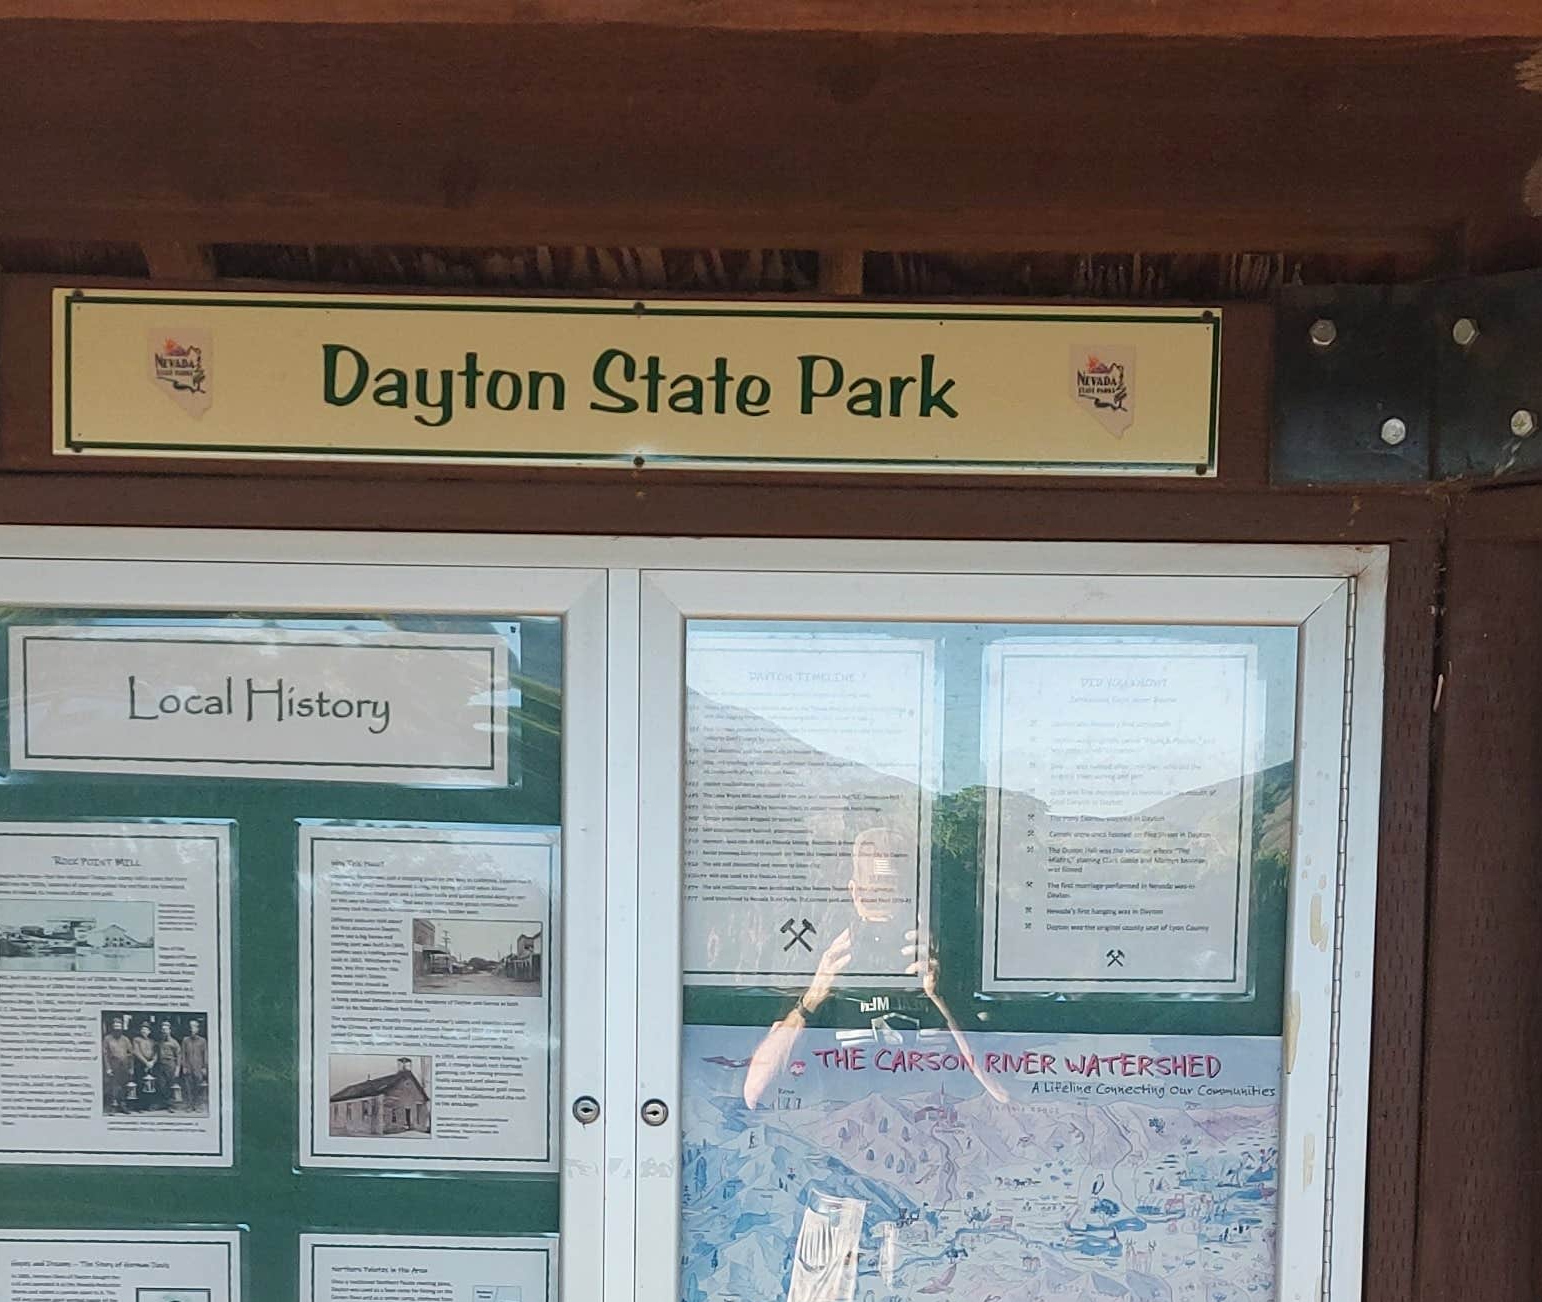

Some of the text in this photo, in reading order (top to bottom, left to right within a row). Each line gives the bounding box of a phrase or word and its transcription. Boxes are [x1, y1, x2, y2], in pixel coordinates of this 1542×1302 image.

[321, 343, 960, 426] Dayton State Park
[1077, 369, 1117, 385] NEVADA
[127, 675, 391, 734] Local History
[81, 857, 112, 867] POINT
[115, 857, 141, 867] MILL
[812, 1047, 1221, 1078] THE CARSON RIVER WATERSHED
[1031, 1083, 1040, 1094] A
[1045, 1082, 1091, 1094] Lifeline
[1096, 1083, 1165, 1098] Connecting
[1197, 1085, 1276, 1097] Communities
